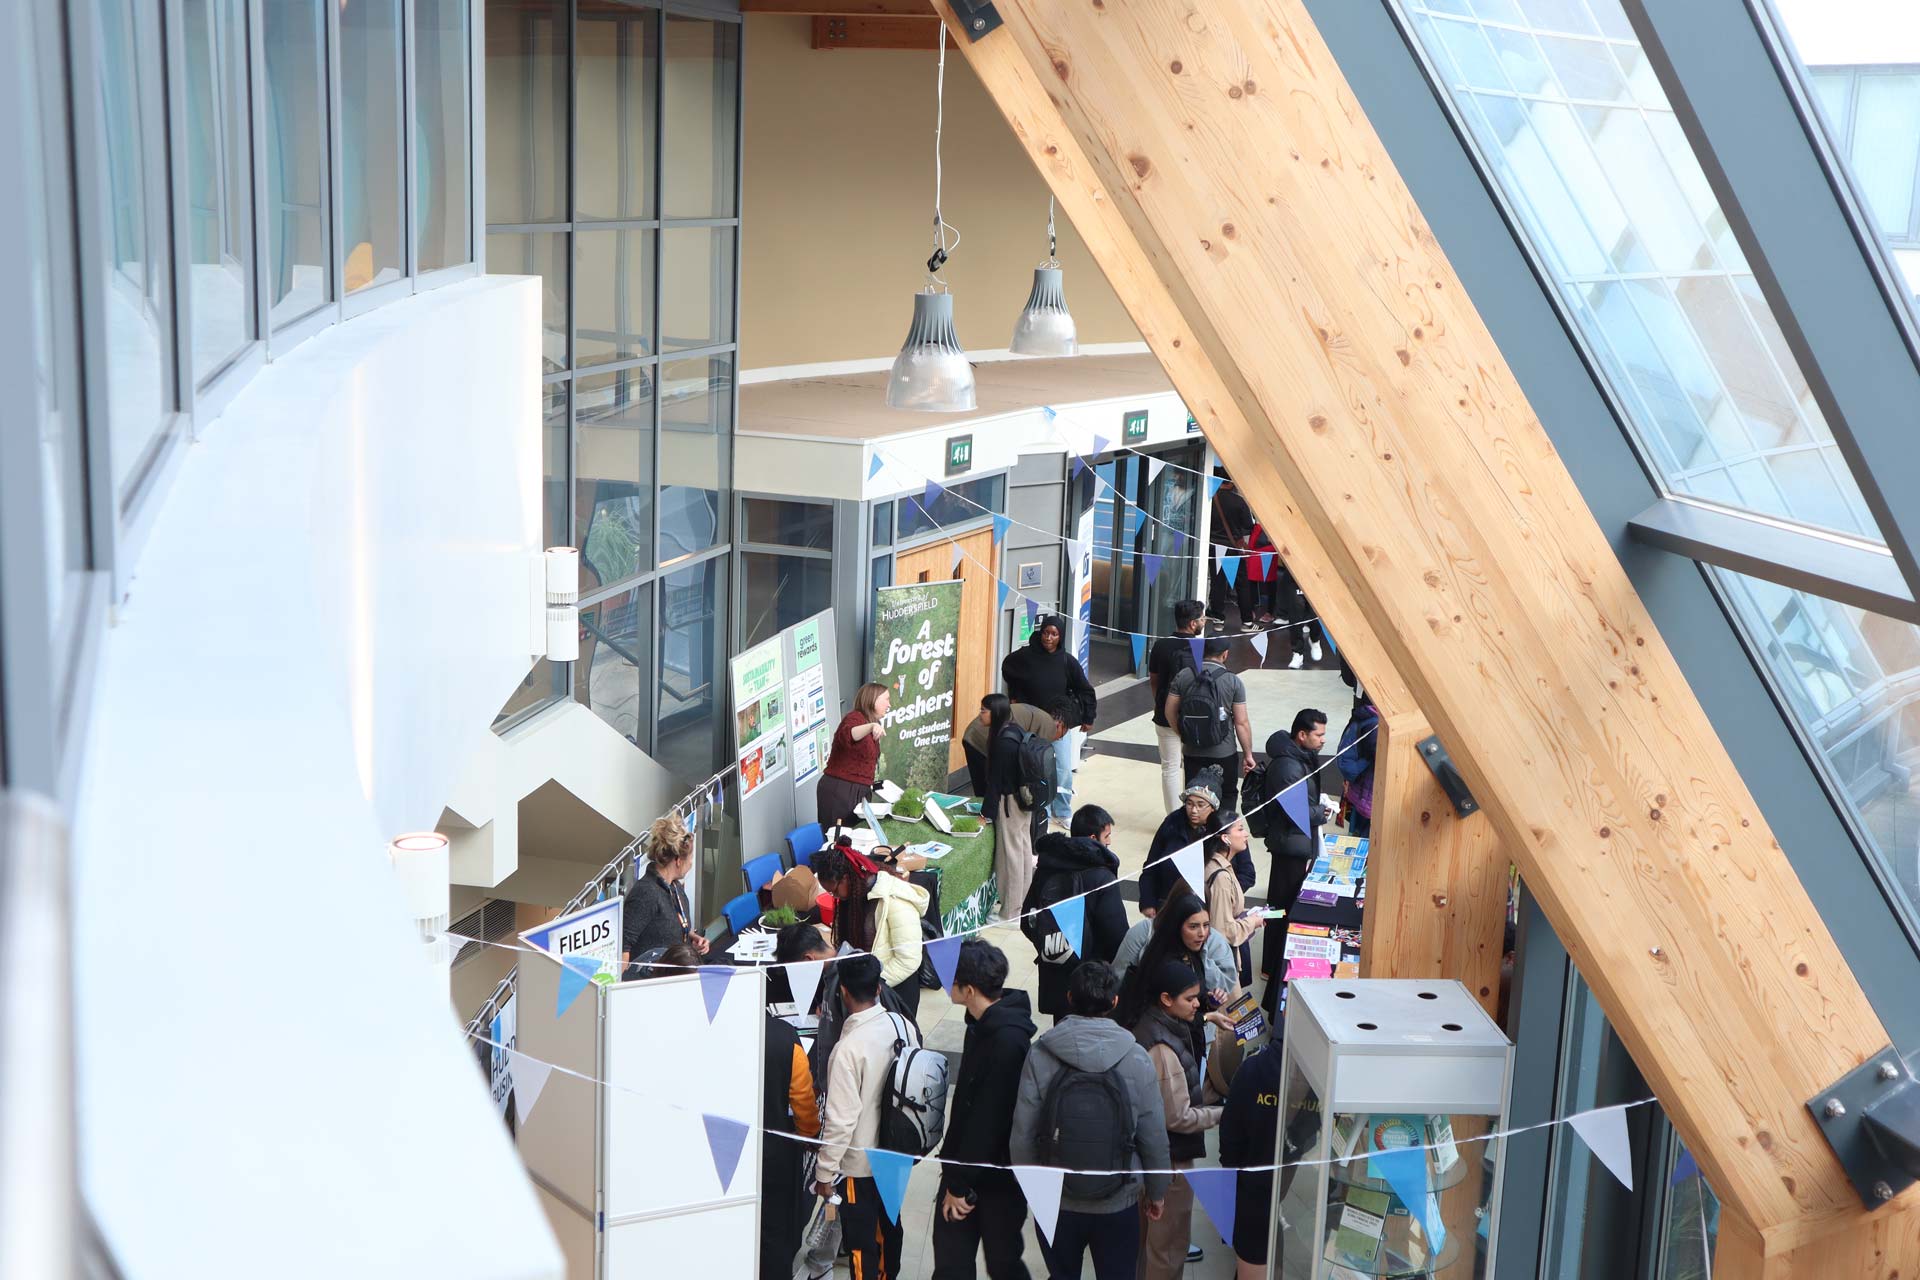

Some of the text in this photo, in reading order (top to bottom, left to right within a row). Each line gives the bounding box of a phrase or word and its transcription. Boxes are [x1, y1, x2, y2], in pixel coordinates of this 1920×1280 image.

[881, 597, 938, 622] HUDDERSFIELD
[916, 619, 931, 640] A
[797, 642, 818, 660] rewards
[799, 633, 814, 650] green
[881, 633, 955, 675] forest
[918, 659, 942, 690] of
[899, 719, 951, 740] One student.
[914, 733, 950, 748] One tree.
[559, 919, 610, 955] FIELDS
